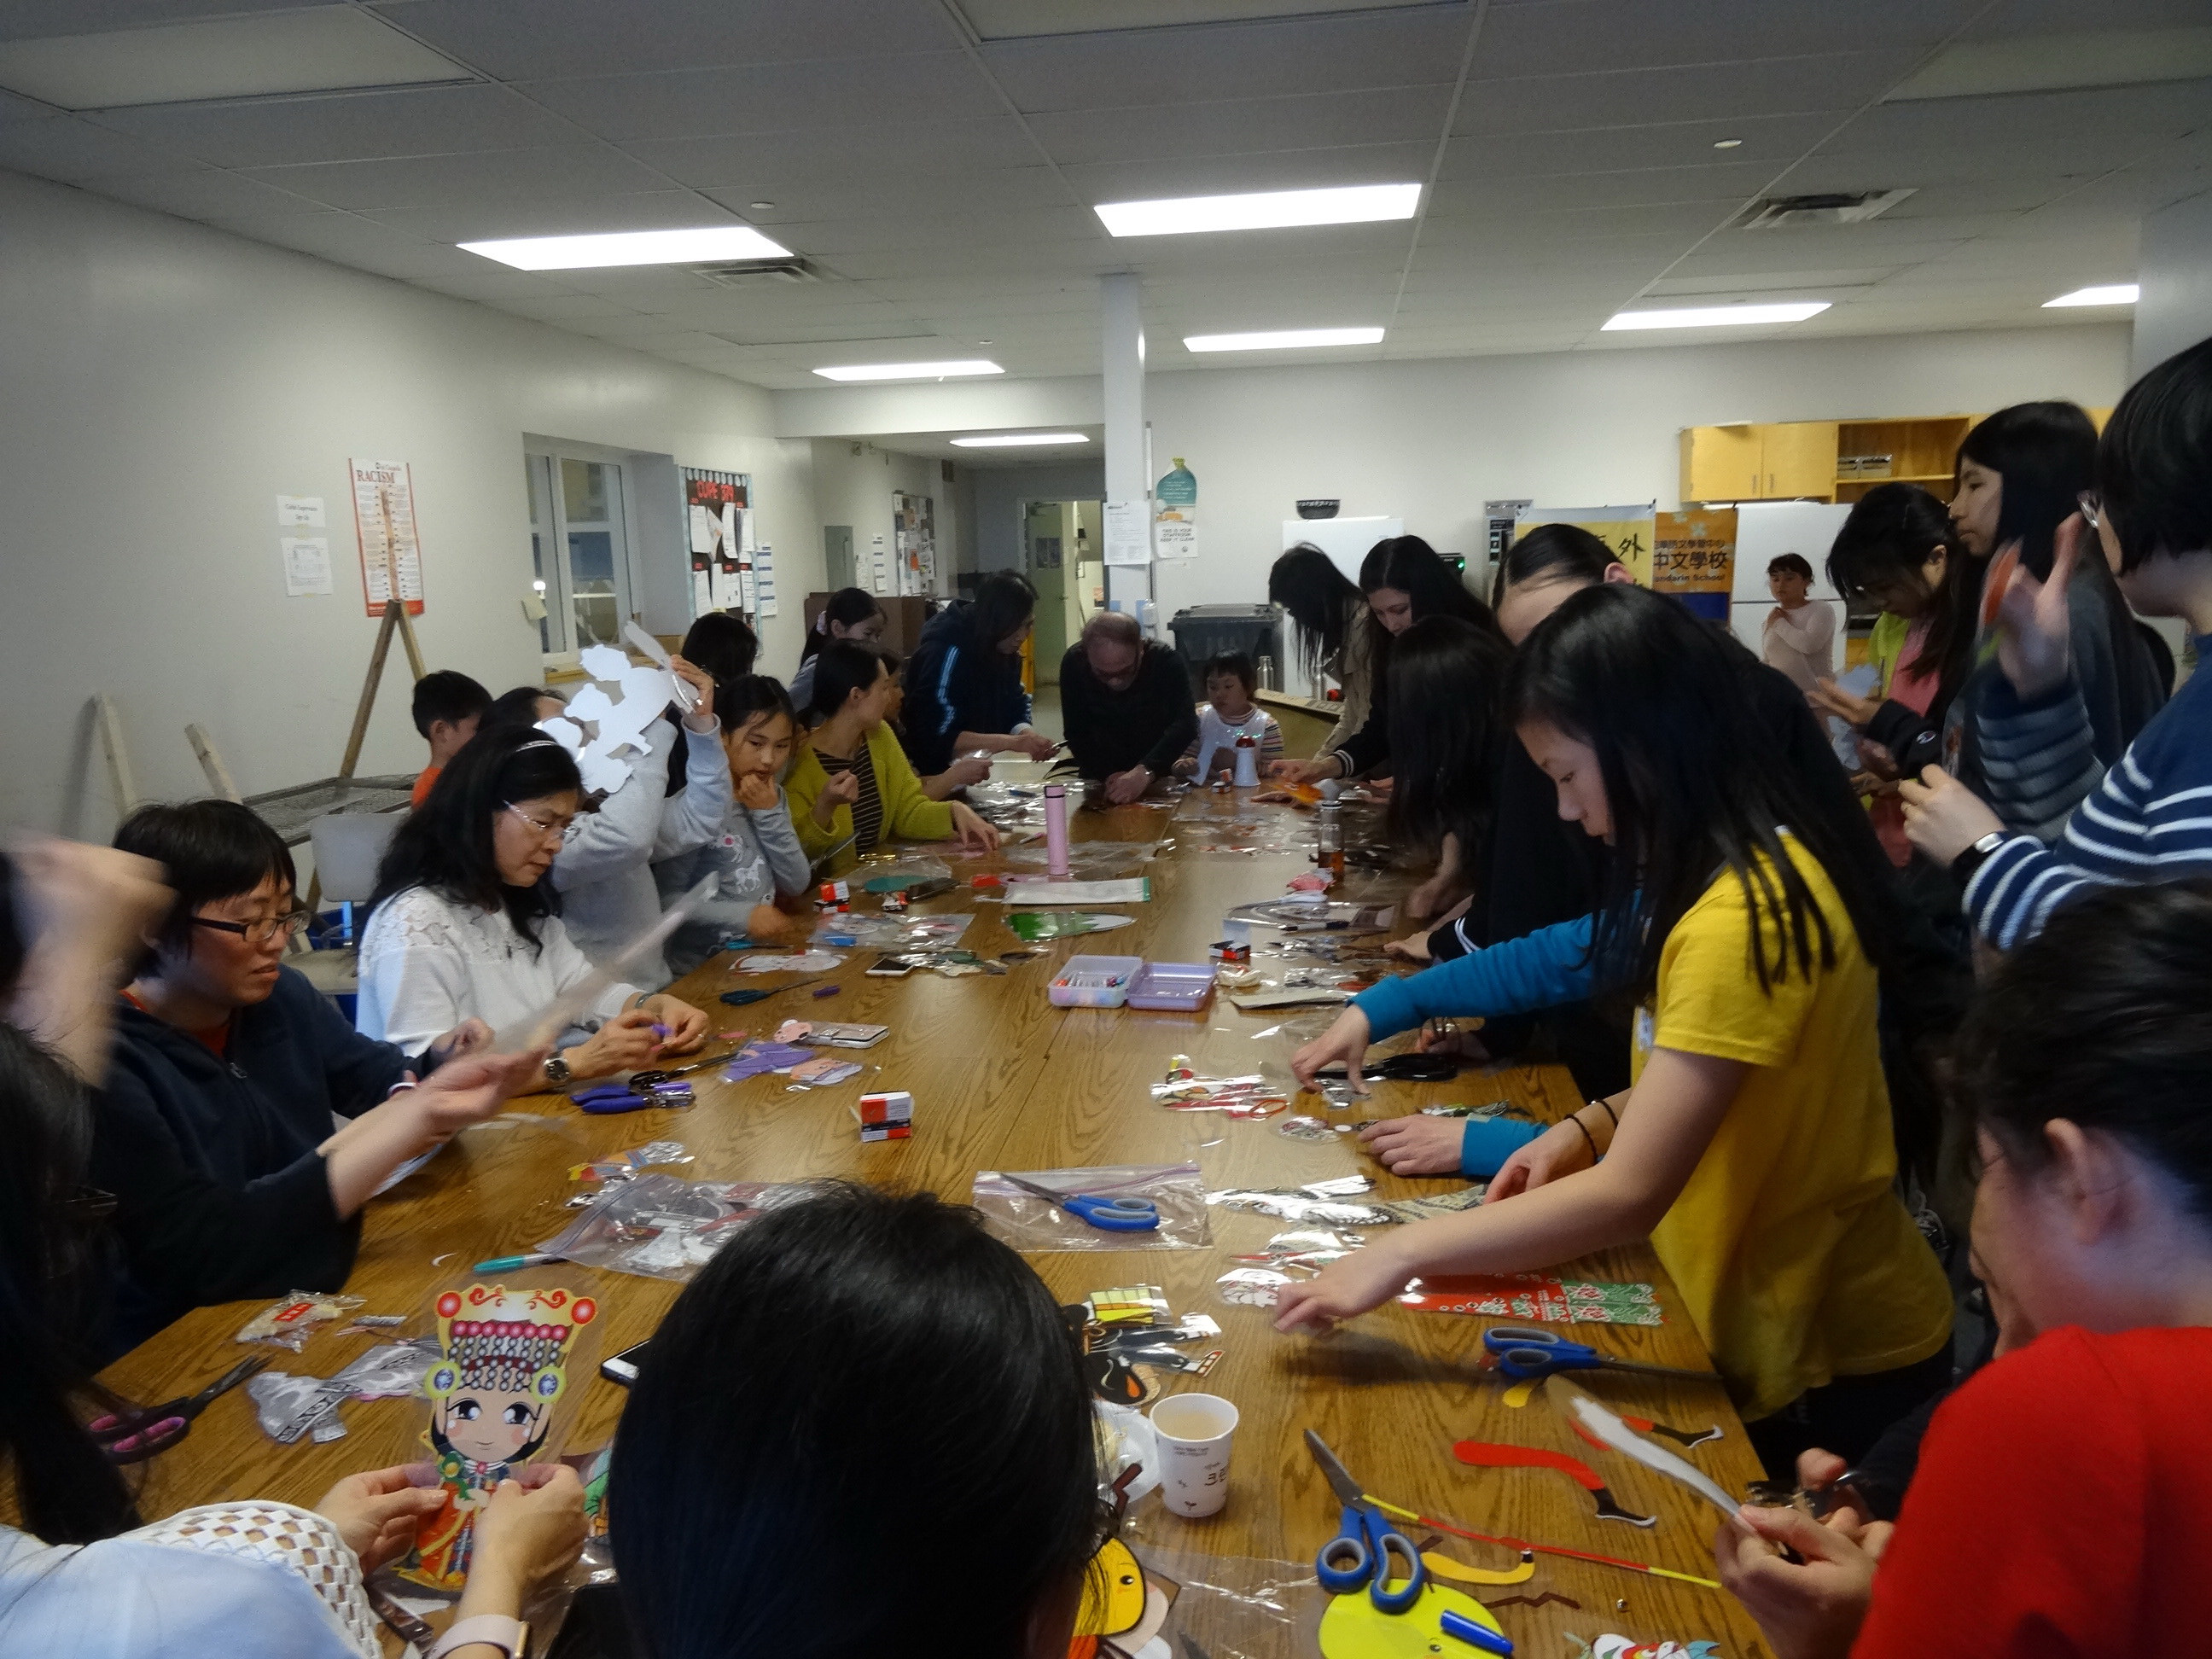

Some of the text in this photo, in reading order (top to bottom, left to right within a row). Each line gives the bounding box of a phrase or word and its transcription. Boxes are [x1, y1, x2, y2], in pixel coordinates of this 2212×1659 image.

[356, 469, 395, 484] RACISM
[1654, 550, 1727, 570] 中文學校
[1654, 574, 1690, 583] andarin
[1693, 573, 1726, 582] School
